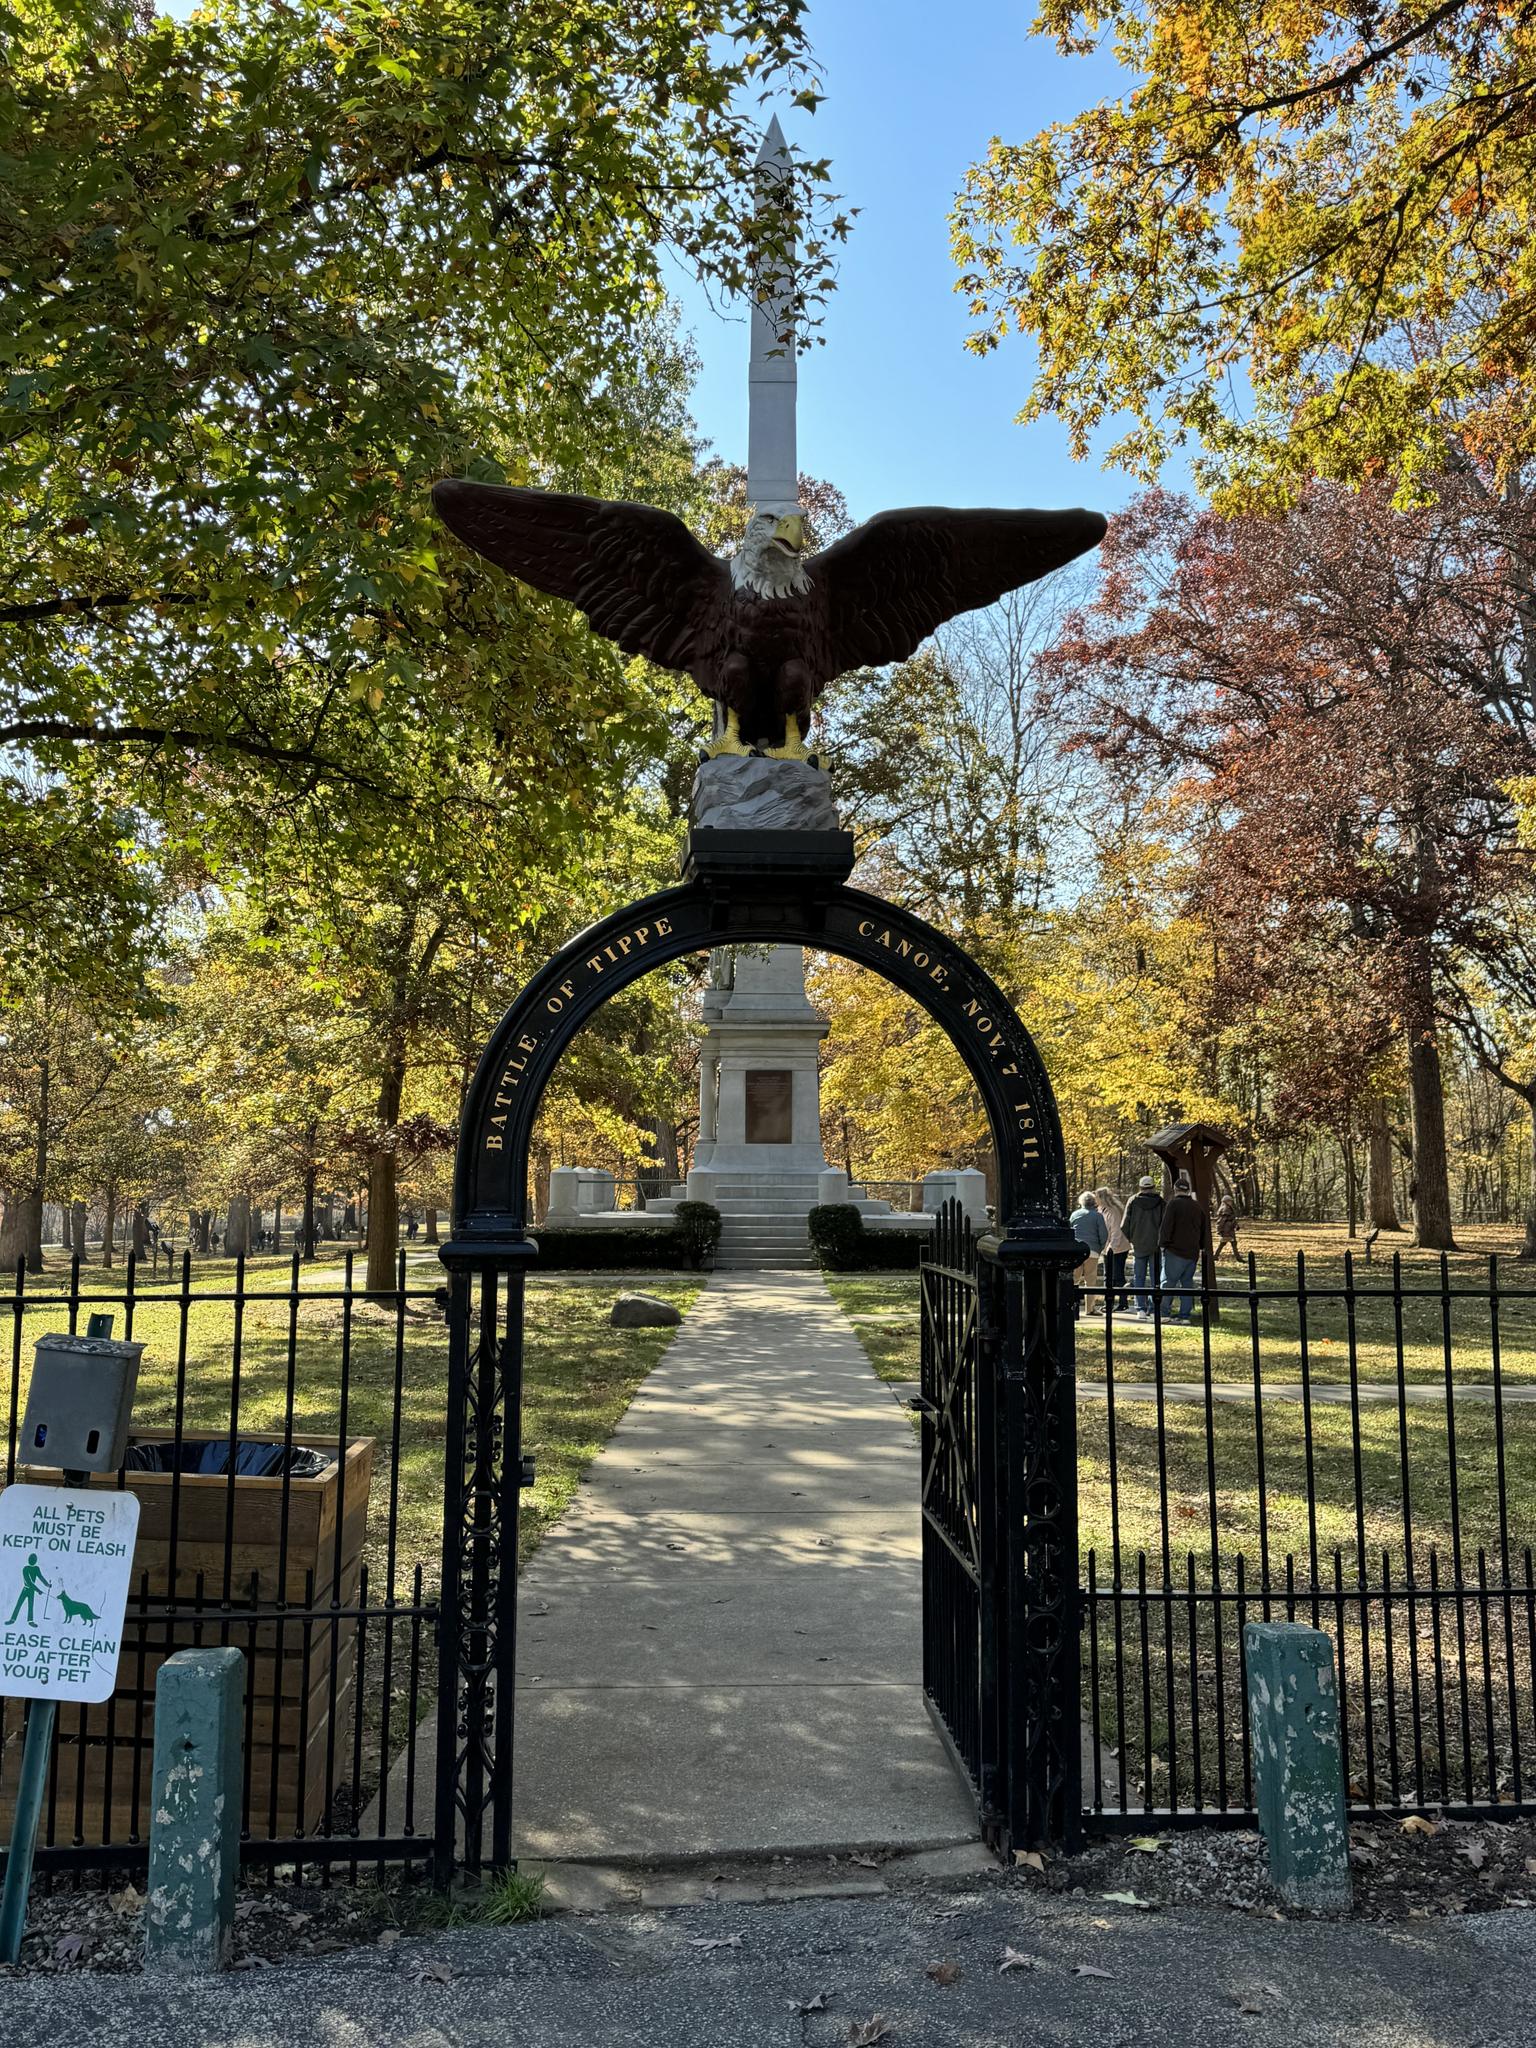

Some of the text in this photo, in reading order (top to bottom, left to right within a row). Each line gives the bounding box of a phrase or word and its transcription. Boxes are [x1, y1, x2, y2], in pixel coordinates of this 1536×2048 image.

[486, 917, 673, 1151] BATTLE OF TIPPE
[858, 920, 950, 992] CANOE,
[1002, 1062, 1018, 1076] 7
[1014, 1103, 1040, 1168] 1811.
[33, 1505, 105, 1524] ALL PETS
[32, 1521, 101, 1539] MUST BE
[2, 1534, 127, 1557] KEPT ON LEASH
[0, 1632, 116, 1655] EASE CLEAN
[5, 1648, 91, 1668] UP AFTER
[2, 1663, 91, 1683] YOUR PET
